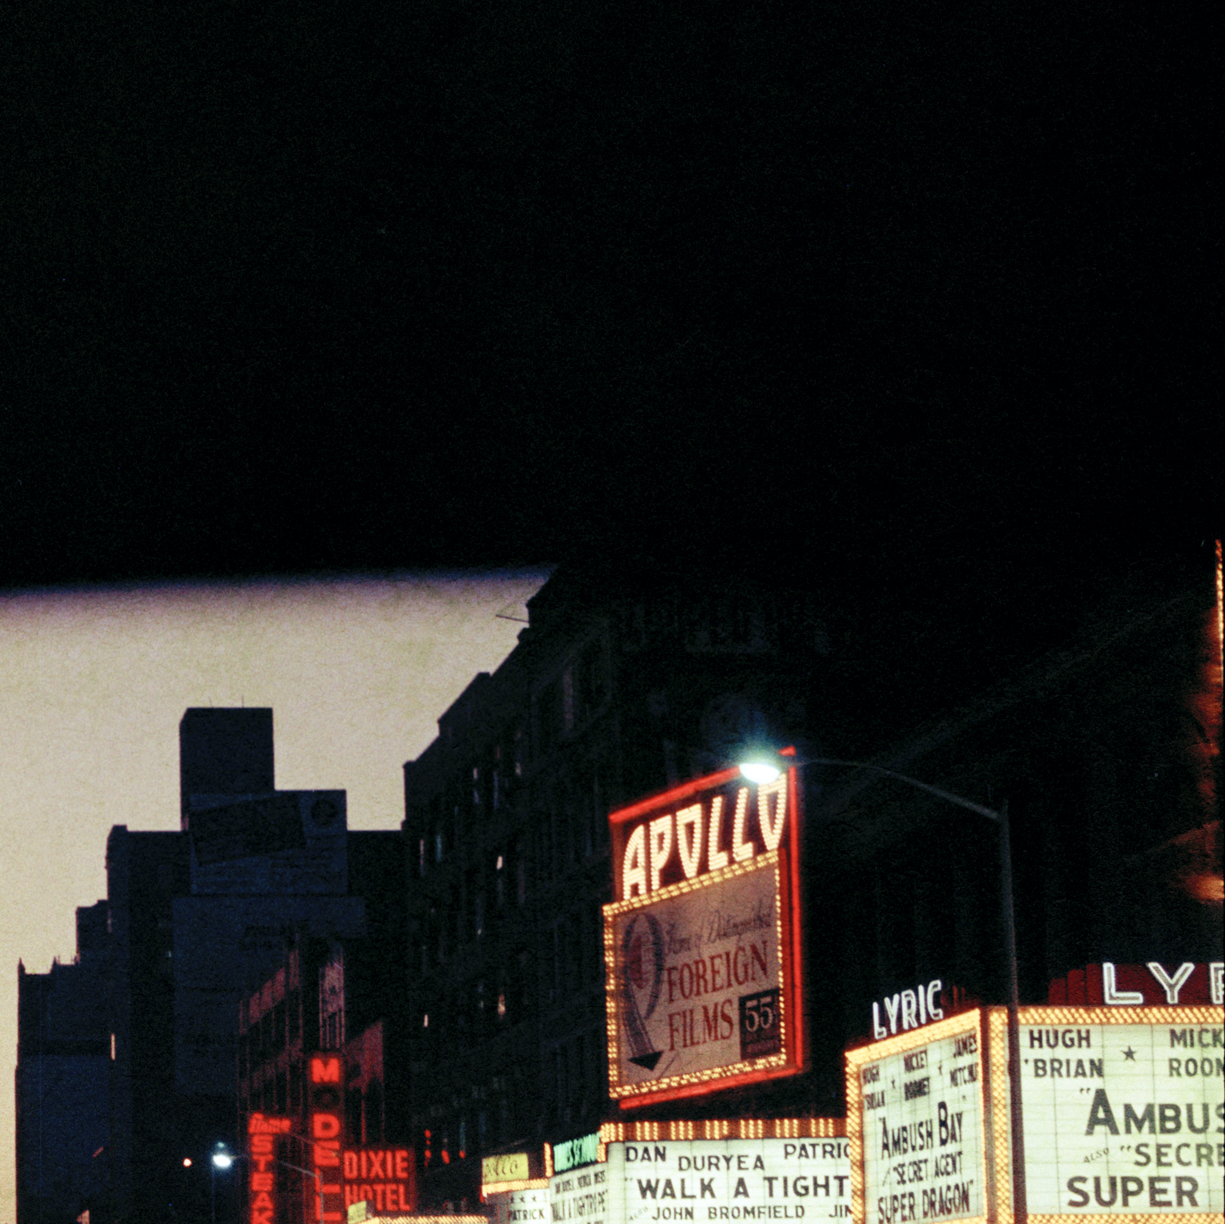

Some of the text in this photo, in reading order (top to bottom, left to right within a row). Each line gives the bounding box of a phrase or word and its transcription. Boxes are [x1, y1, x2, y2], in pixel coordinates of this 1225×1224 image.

[623, 773, 787, 900] APOLLO
[665, 940, 769, 1004] FOREIGN
[668, 999, 735, 1051] FILMS
[872, 979, 944, 1040] LYRIC
[1029, 1029, 1224, 1049] HUGH MICK
[937, 1101, 964, 1147] BAY
[343, 1150, 409, 1179] DIXIE
[625, 1145, 667, 1163] DAN
[678, 1154, 765, 1172] DURYEA
[344, 1183, 411, 1212] HOTEL
[733, 1177, 750, 1198] A
[764, 1175, 849, 1197] TIGHT
[1066, 1176, 1200, 1207] SUPER
[651, 1207, 694, 1220] JOHN
[707, 1206, 805, 1220] BROMFIELD
[878, 1191, 916, 1224] SUPER
